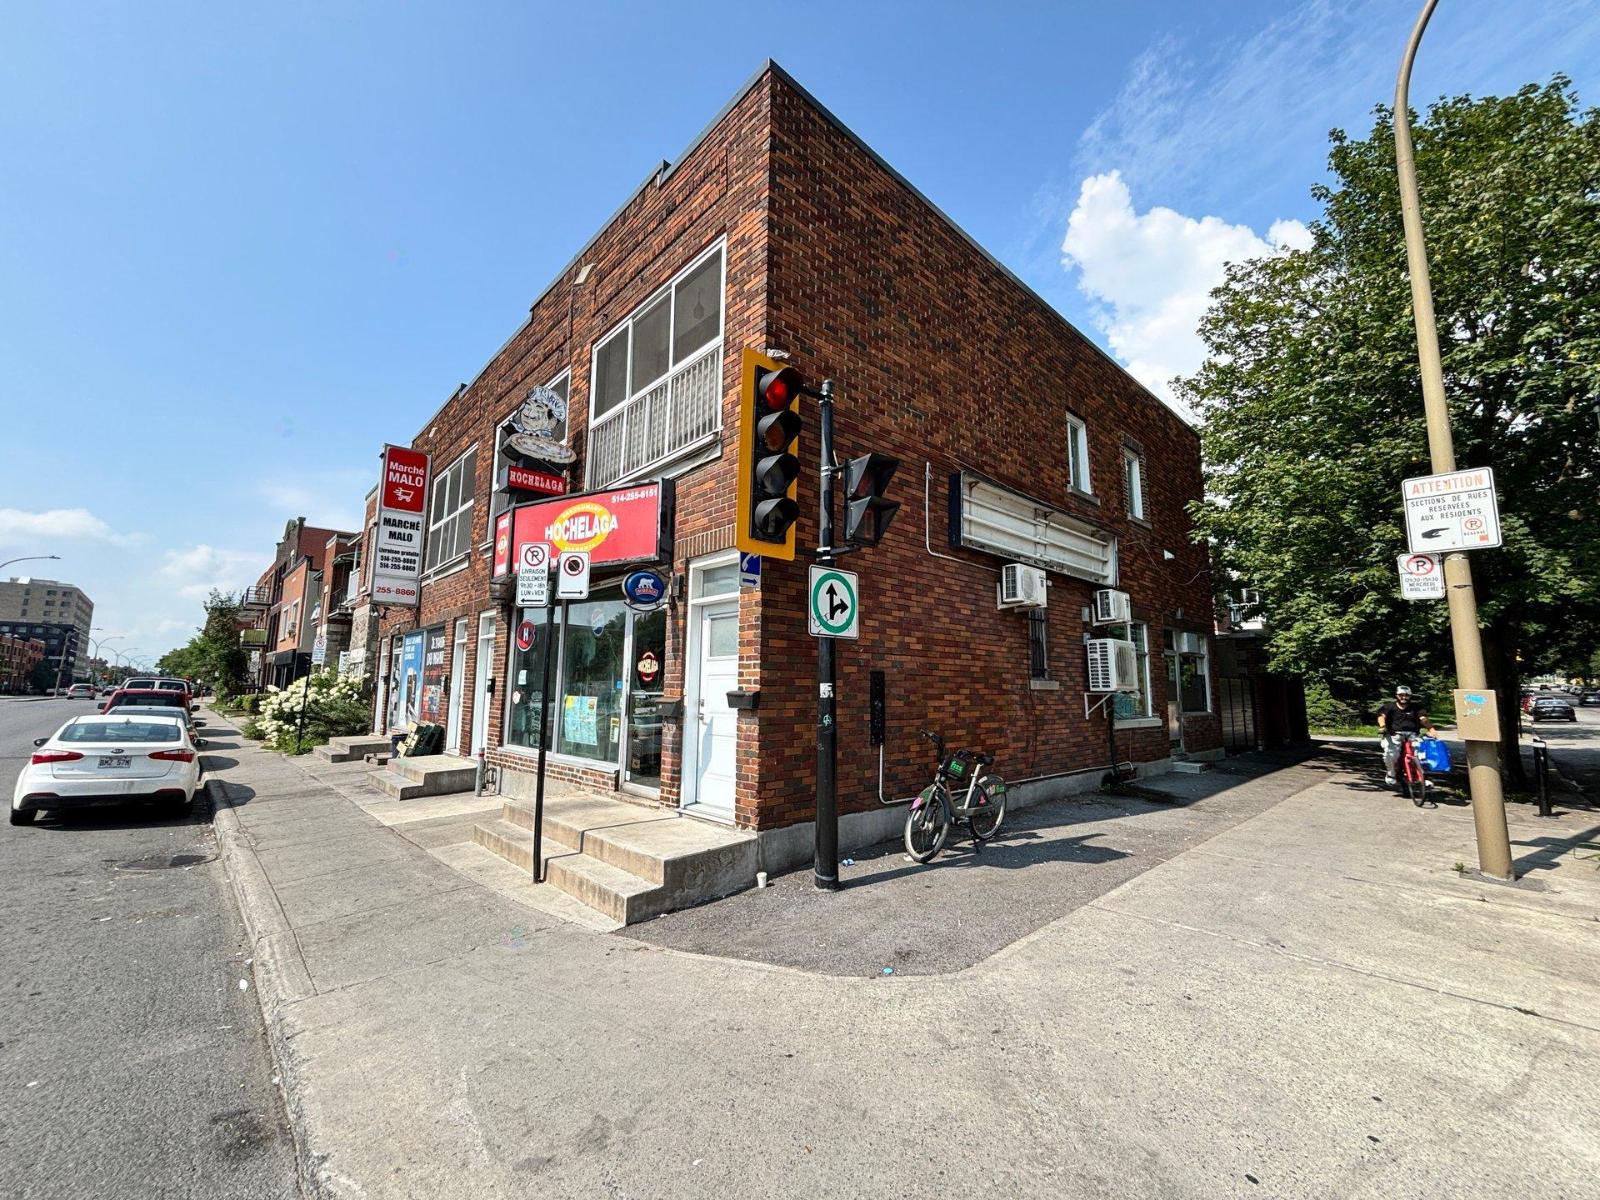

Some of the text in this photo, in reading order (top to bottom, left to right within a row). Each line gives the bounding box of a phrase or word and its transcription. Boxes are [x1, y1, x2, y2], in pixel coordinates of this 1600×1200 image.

[389, 461, 424, 476] Marché
[388, 472, 424, 488] MALO
[509, 470, 564, 492] HOCHELAGA
[1412, 474, 1484, 494] ATTENTION
[1410, 496, 1446, 508] SECTIONS
[1468, 492, 1488, 500] RUES
[382, 516, 420, 531] MARCHÉ
[544, 514, 619, 541] HOCHELAGA
[388, 530, 413, 542] MALO
[376, 586, 416, 597] 255-8869
